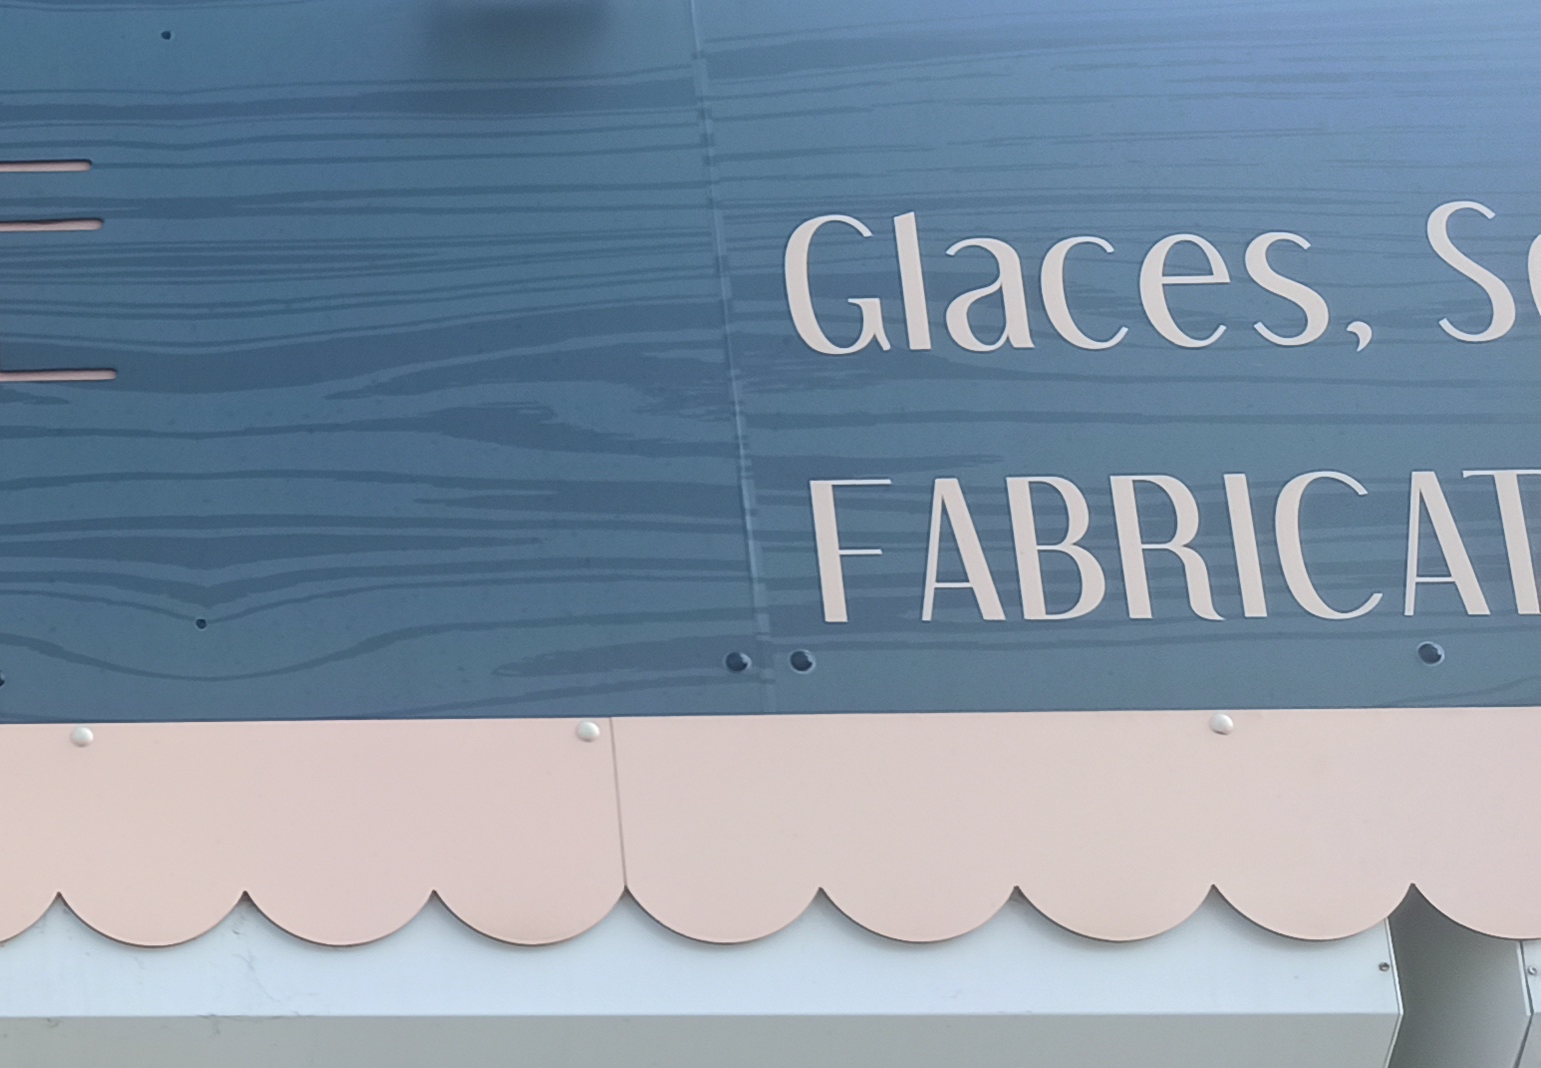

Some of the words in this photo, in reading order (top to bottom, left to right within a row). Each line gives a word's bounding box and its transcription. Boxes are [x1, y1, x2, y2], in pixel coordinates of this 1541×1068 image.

[783, 210, 1373, 356] Glaces,
[1426, 200, 1541, 343] S
[809, 469, 1541, 624] FABRICAT
